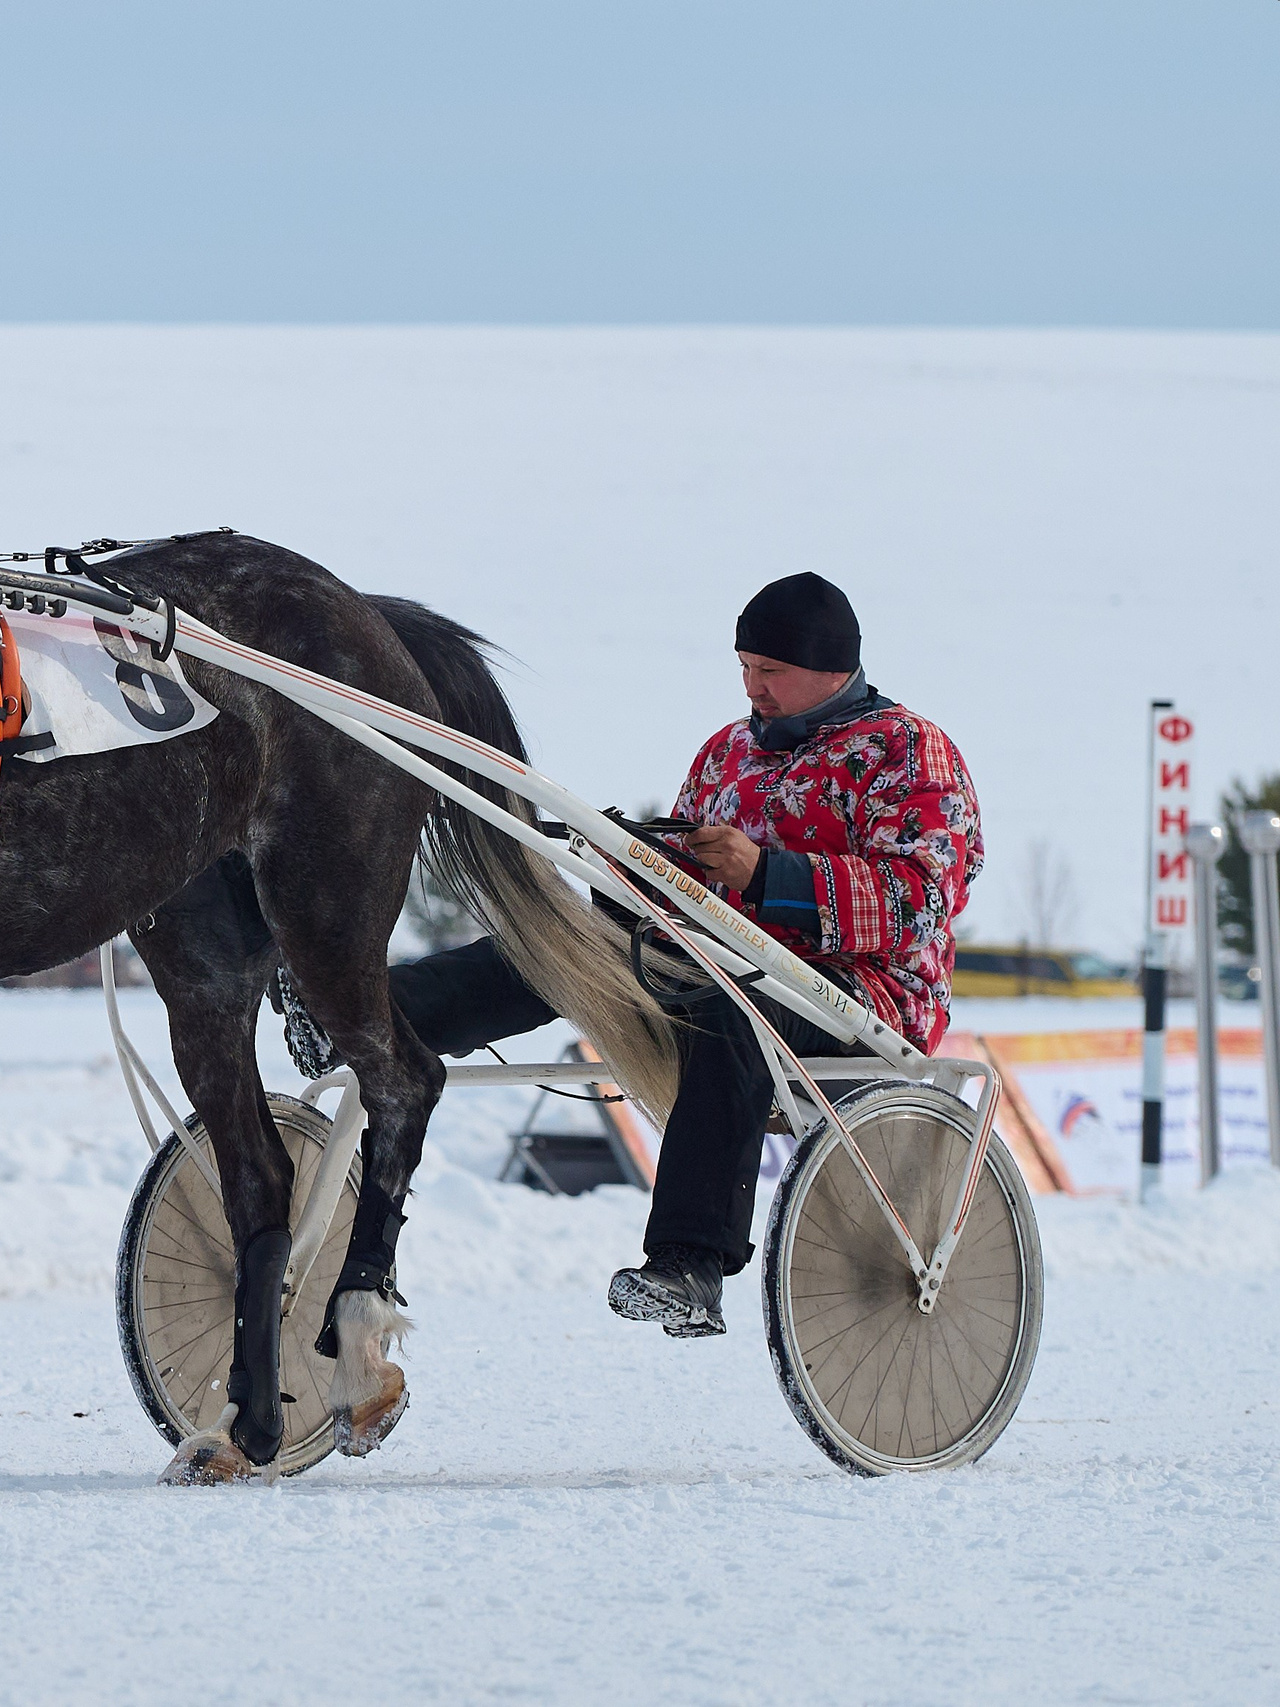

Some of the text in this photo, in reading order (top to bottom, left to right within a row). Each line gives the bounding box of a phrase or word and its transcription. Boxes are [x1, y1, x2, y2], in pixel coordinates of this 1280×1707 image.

[627, 839, 769, 951] CUSTOM MULTIFLEX
[1158, 716, 1192, 925] ФИНИШ
